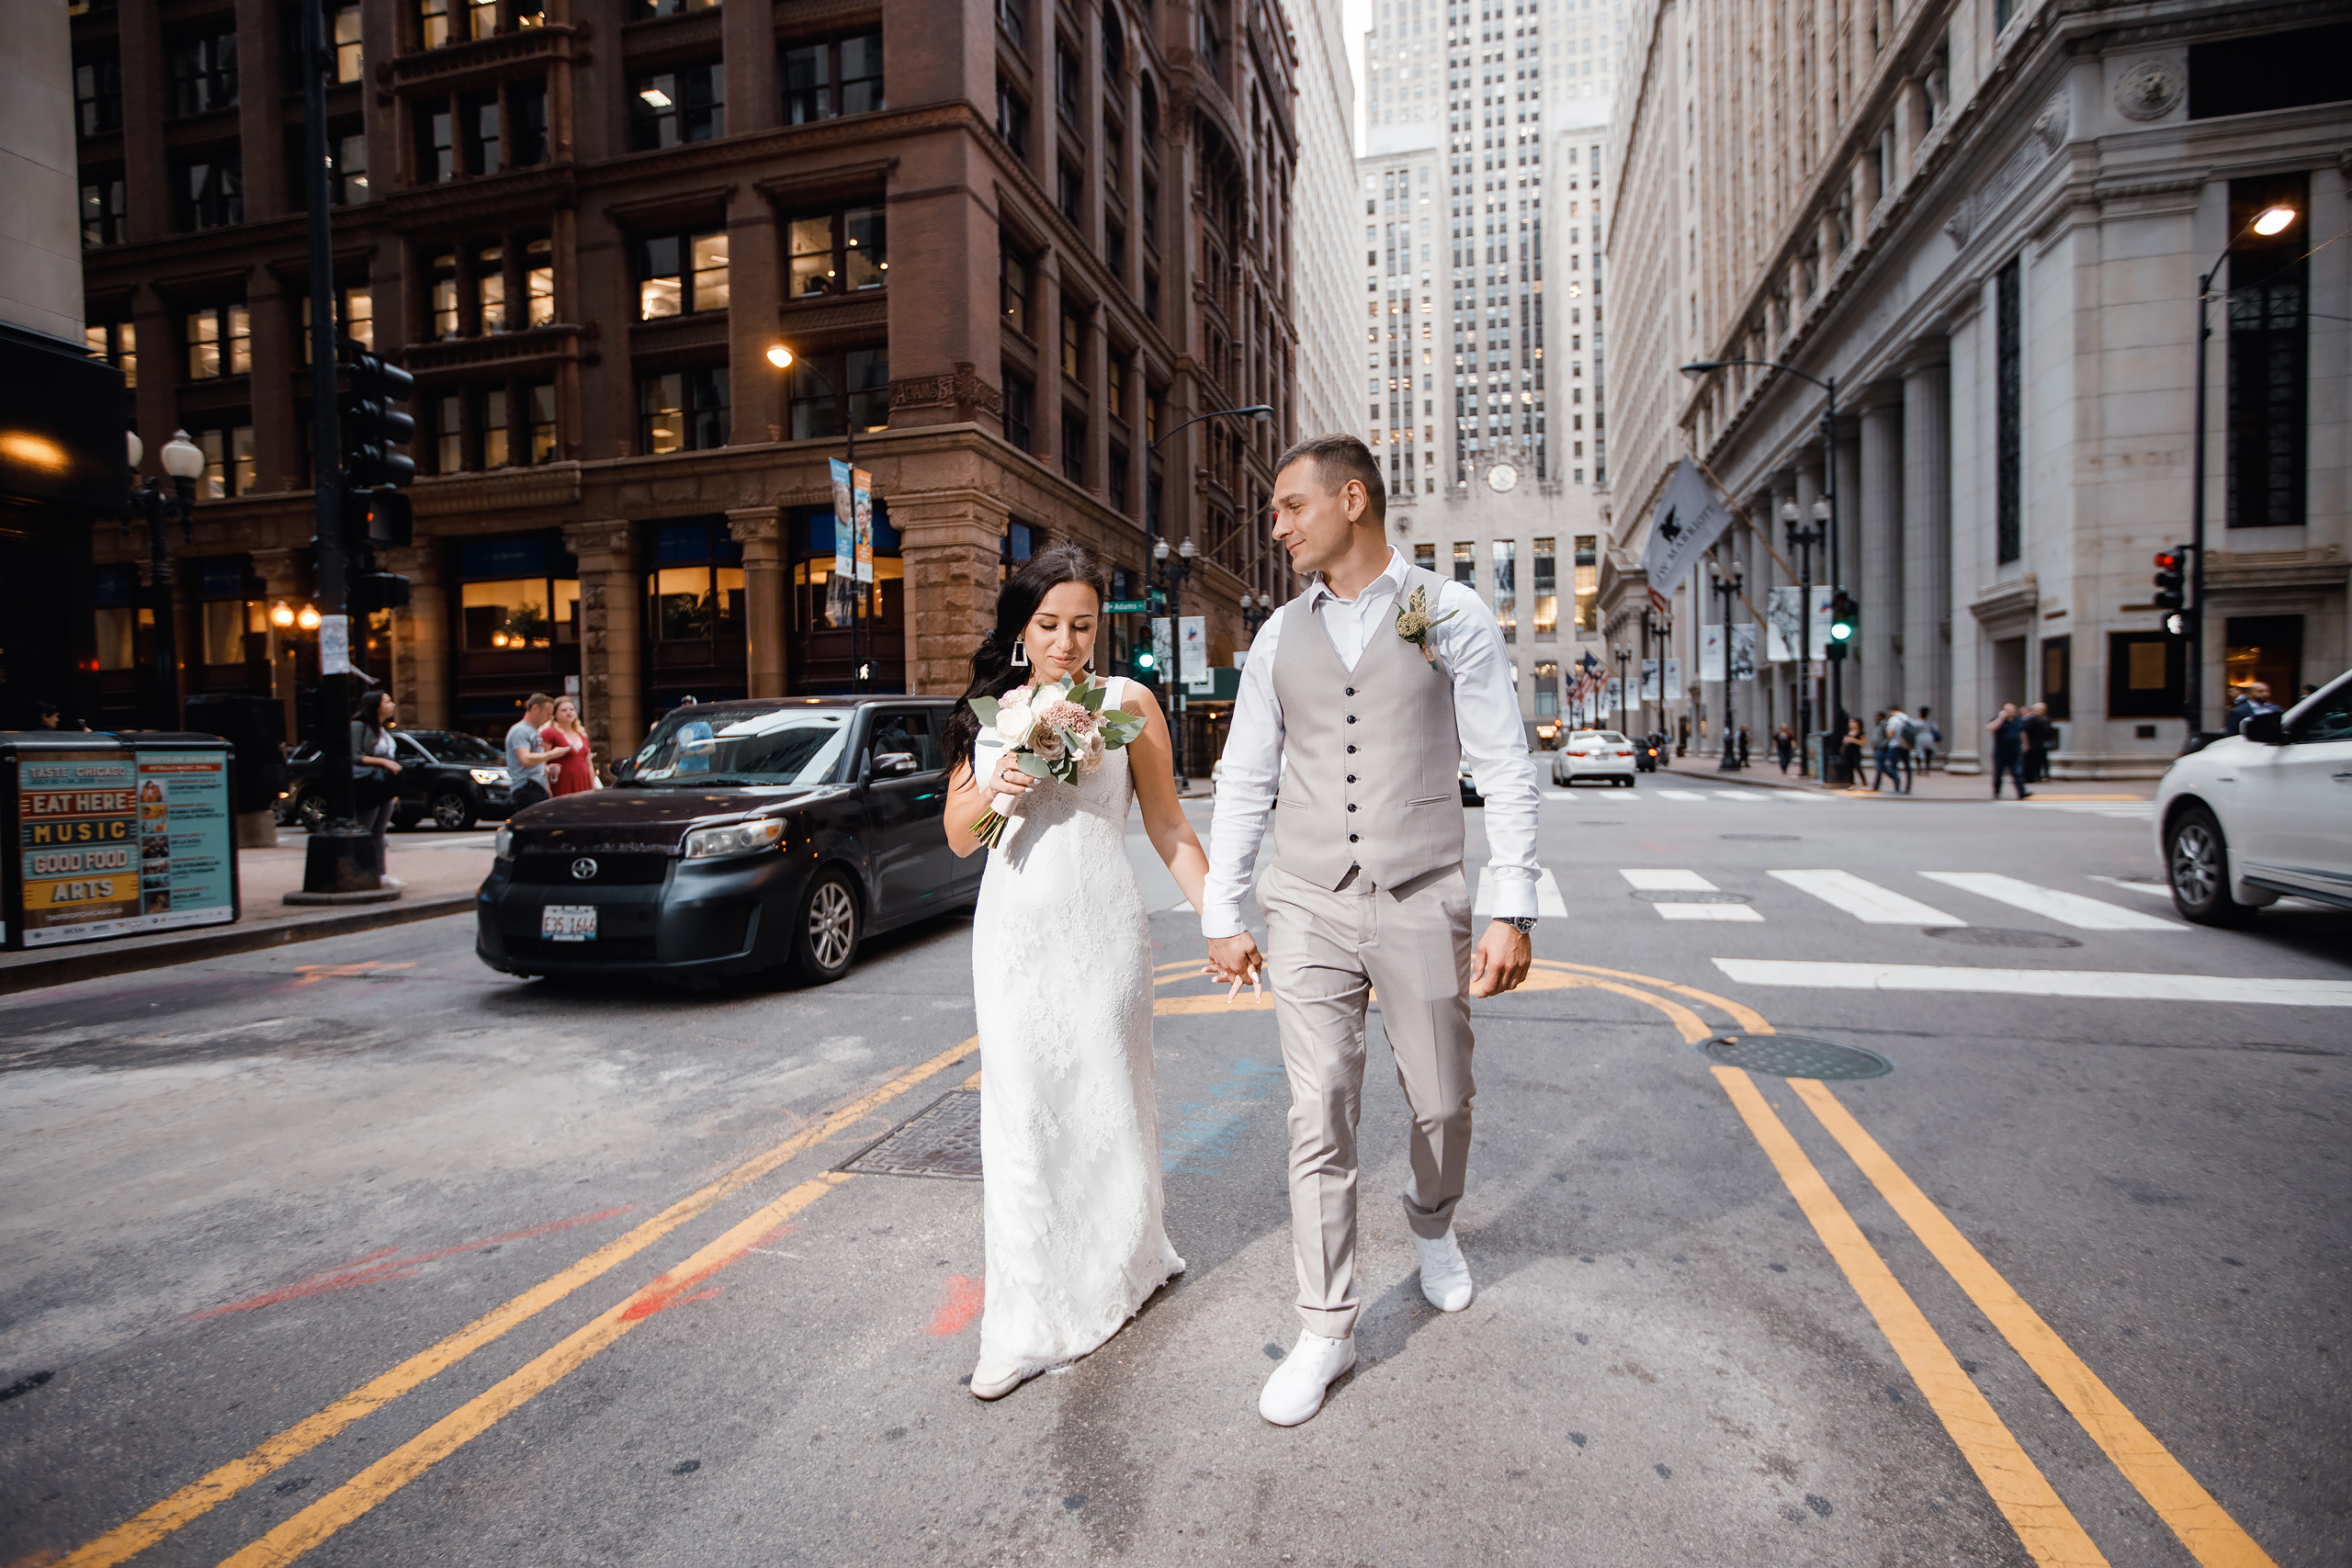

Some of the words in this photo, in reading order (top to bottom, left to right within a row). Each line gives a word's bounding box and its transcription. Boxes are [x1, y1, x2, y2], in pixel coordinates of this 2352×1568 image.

[1668, 502, 1714, 559] MARRIOTT
[30, 768, 69, 778] TASTE
[75, 766, 126, 777] CHICAGO
[33, 795, 73, 813] EAT
[75, 792, 128, 812] HERE
[34, 821, 126, 843] MUSIC
[34, 853, 83, 874] GOOD
[85, 850, 128, 871] FOOD
[51, 878, 115, 903] ARTS
